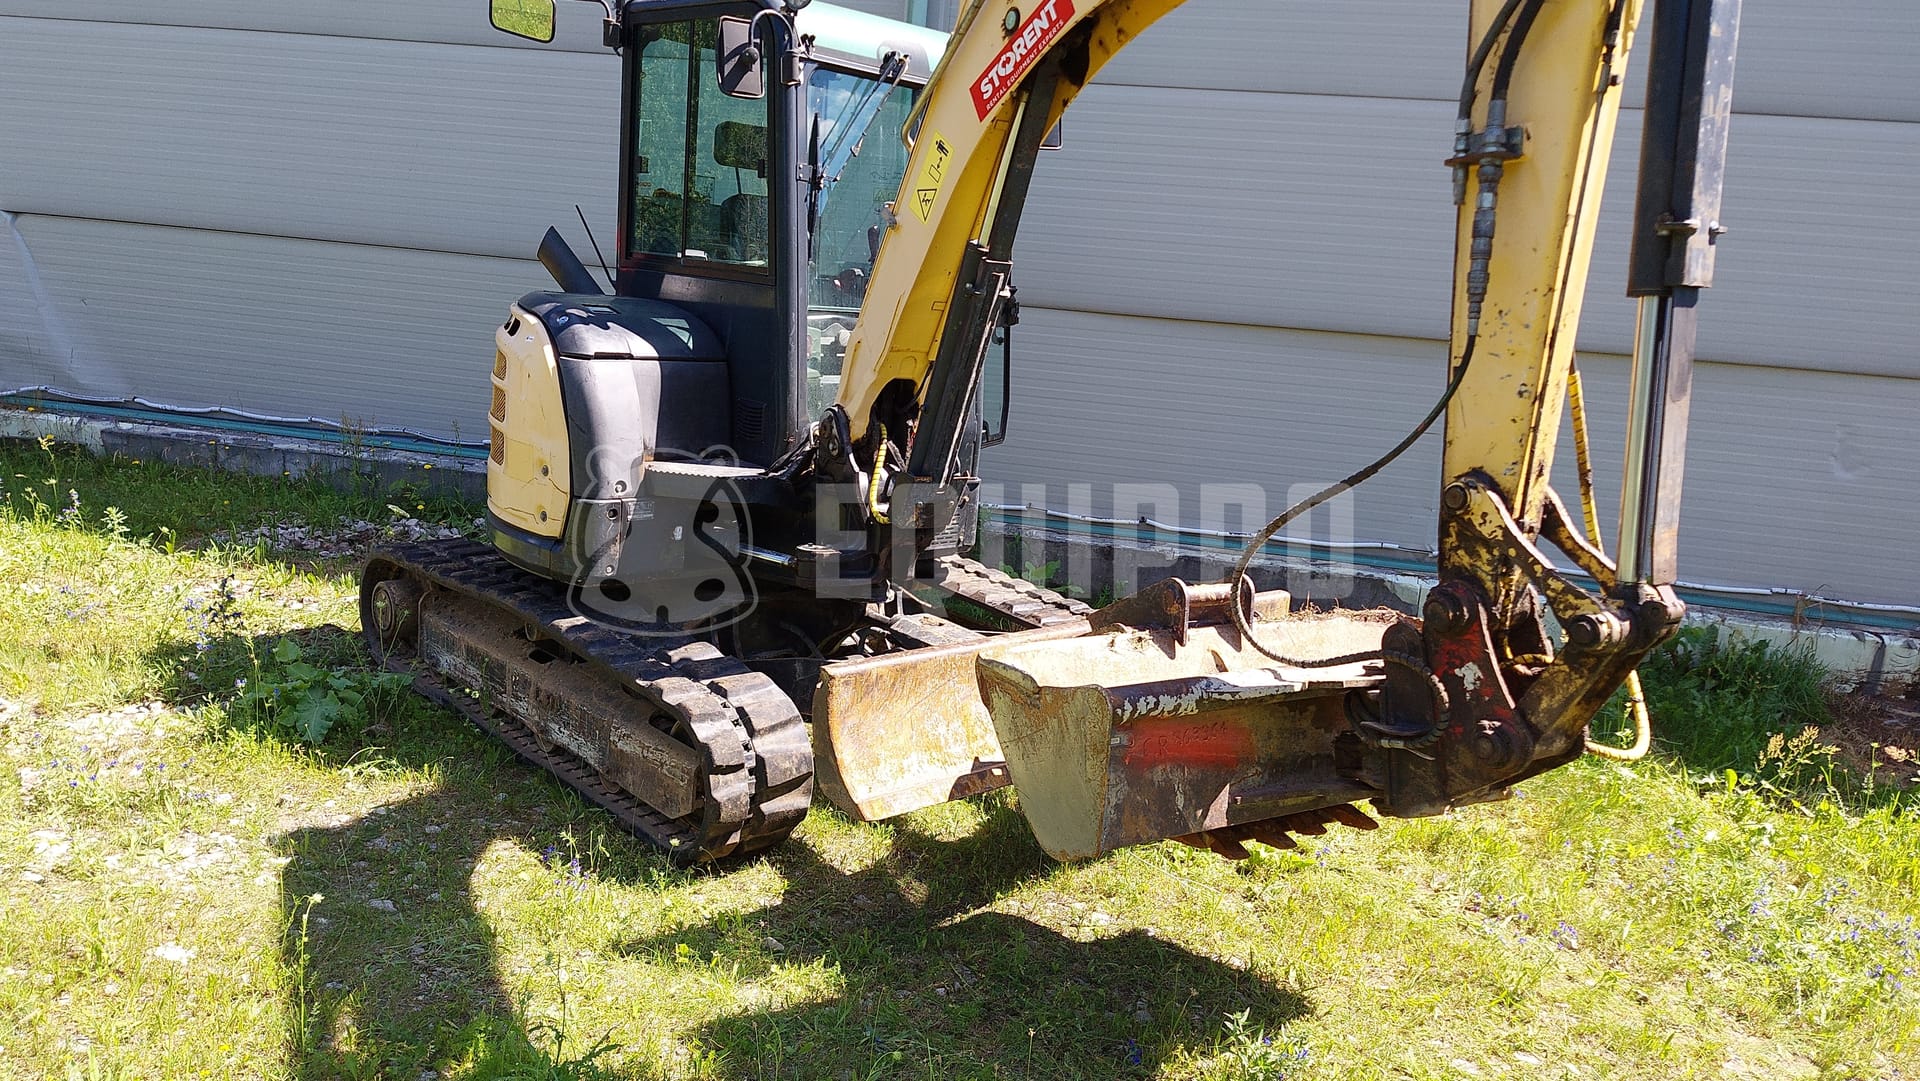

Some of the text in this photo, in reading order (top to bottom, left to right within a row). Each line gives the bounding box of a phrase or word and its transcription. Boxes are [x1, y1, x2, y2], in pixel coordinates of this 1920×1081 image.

[980, 0, 1057, 100] STORENT
[986, 20, 1064, 111] RENTAL EQUIPMENT EXPERTS
